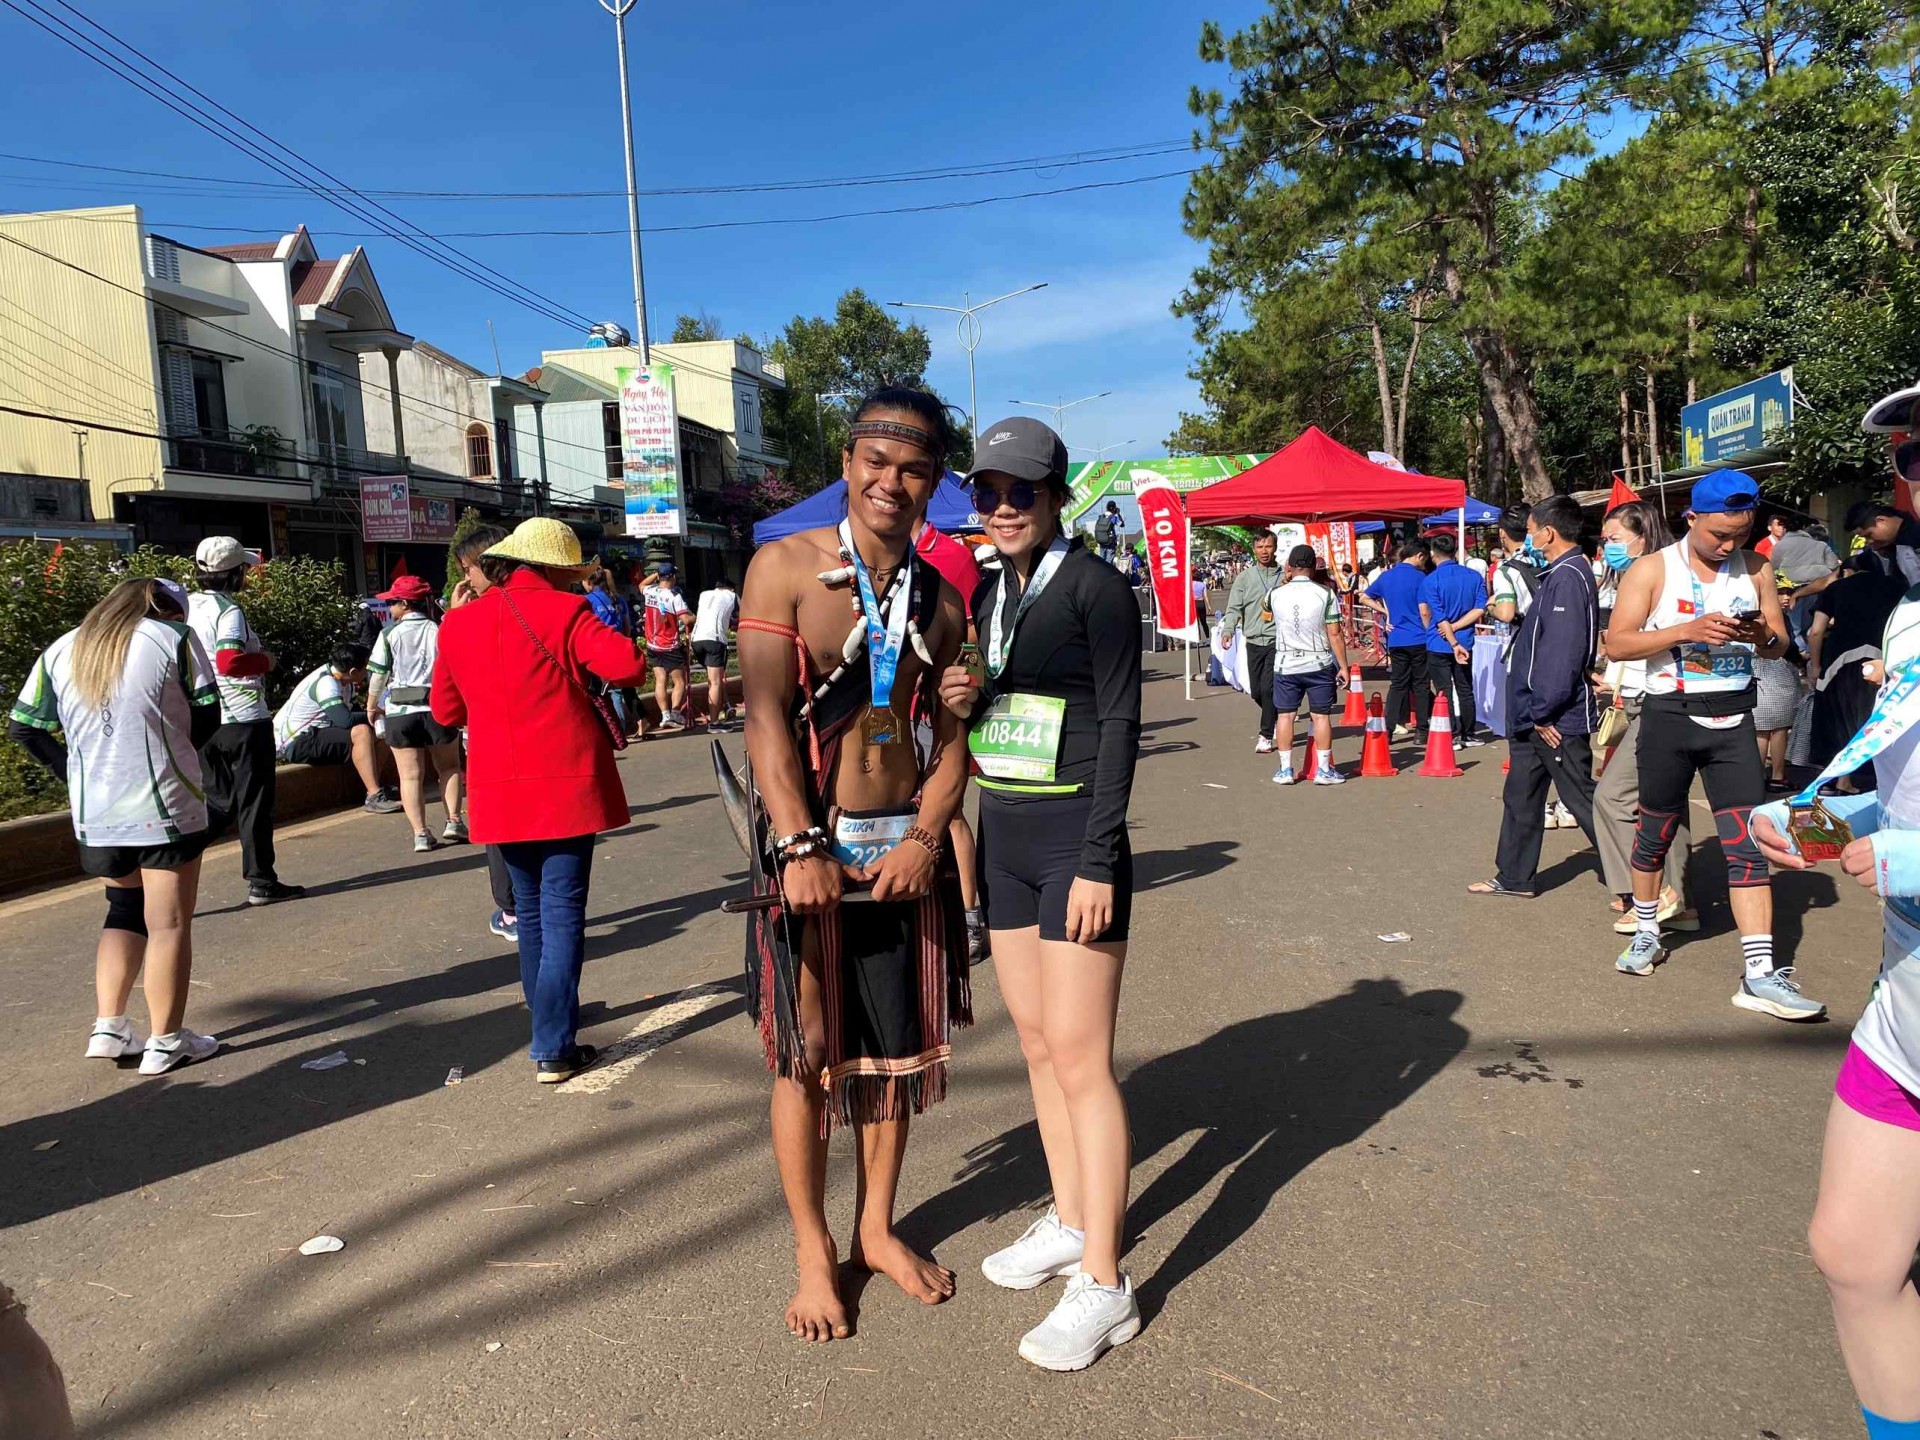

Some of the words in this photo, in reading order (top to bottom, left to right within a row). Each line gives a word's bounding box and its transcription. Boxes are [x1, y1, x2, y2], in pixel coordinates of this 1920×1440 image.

[1711, 409, 1729, 433] QUÁN
[1729, 402, 1751, 426] TRANH
[1133, 477, 1150, 487] Viet
[364, 495, 379, 516] BÚN
[379, 492, 393, 516] CHẢ
[410, 507, 427, 524] HẢ
[1153, 507, 1173, 536] 10
[1158, 540, 1179, 578] KM
[1712, 656, 1745, 672] 232
[980, 721, 1042, 748] 10844
[842, 820, 876, 833] 21KM
